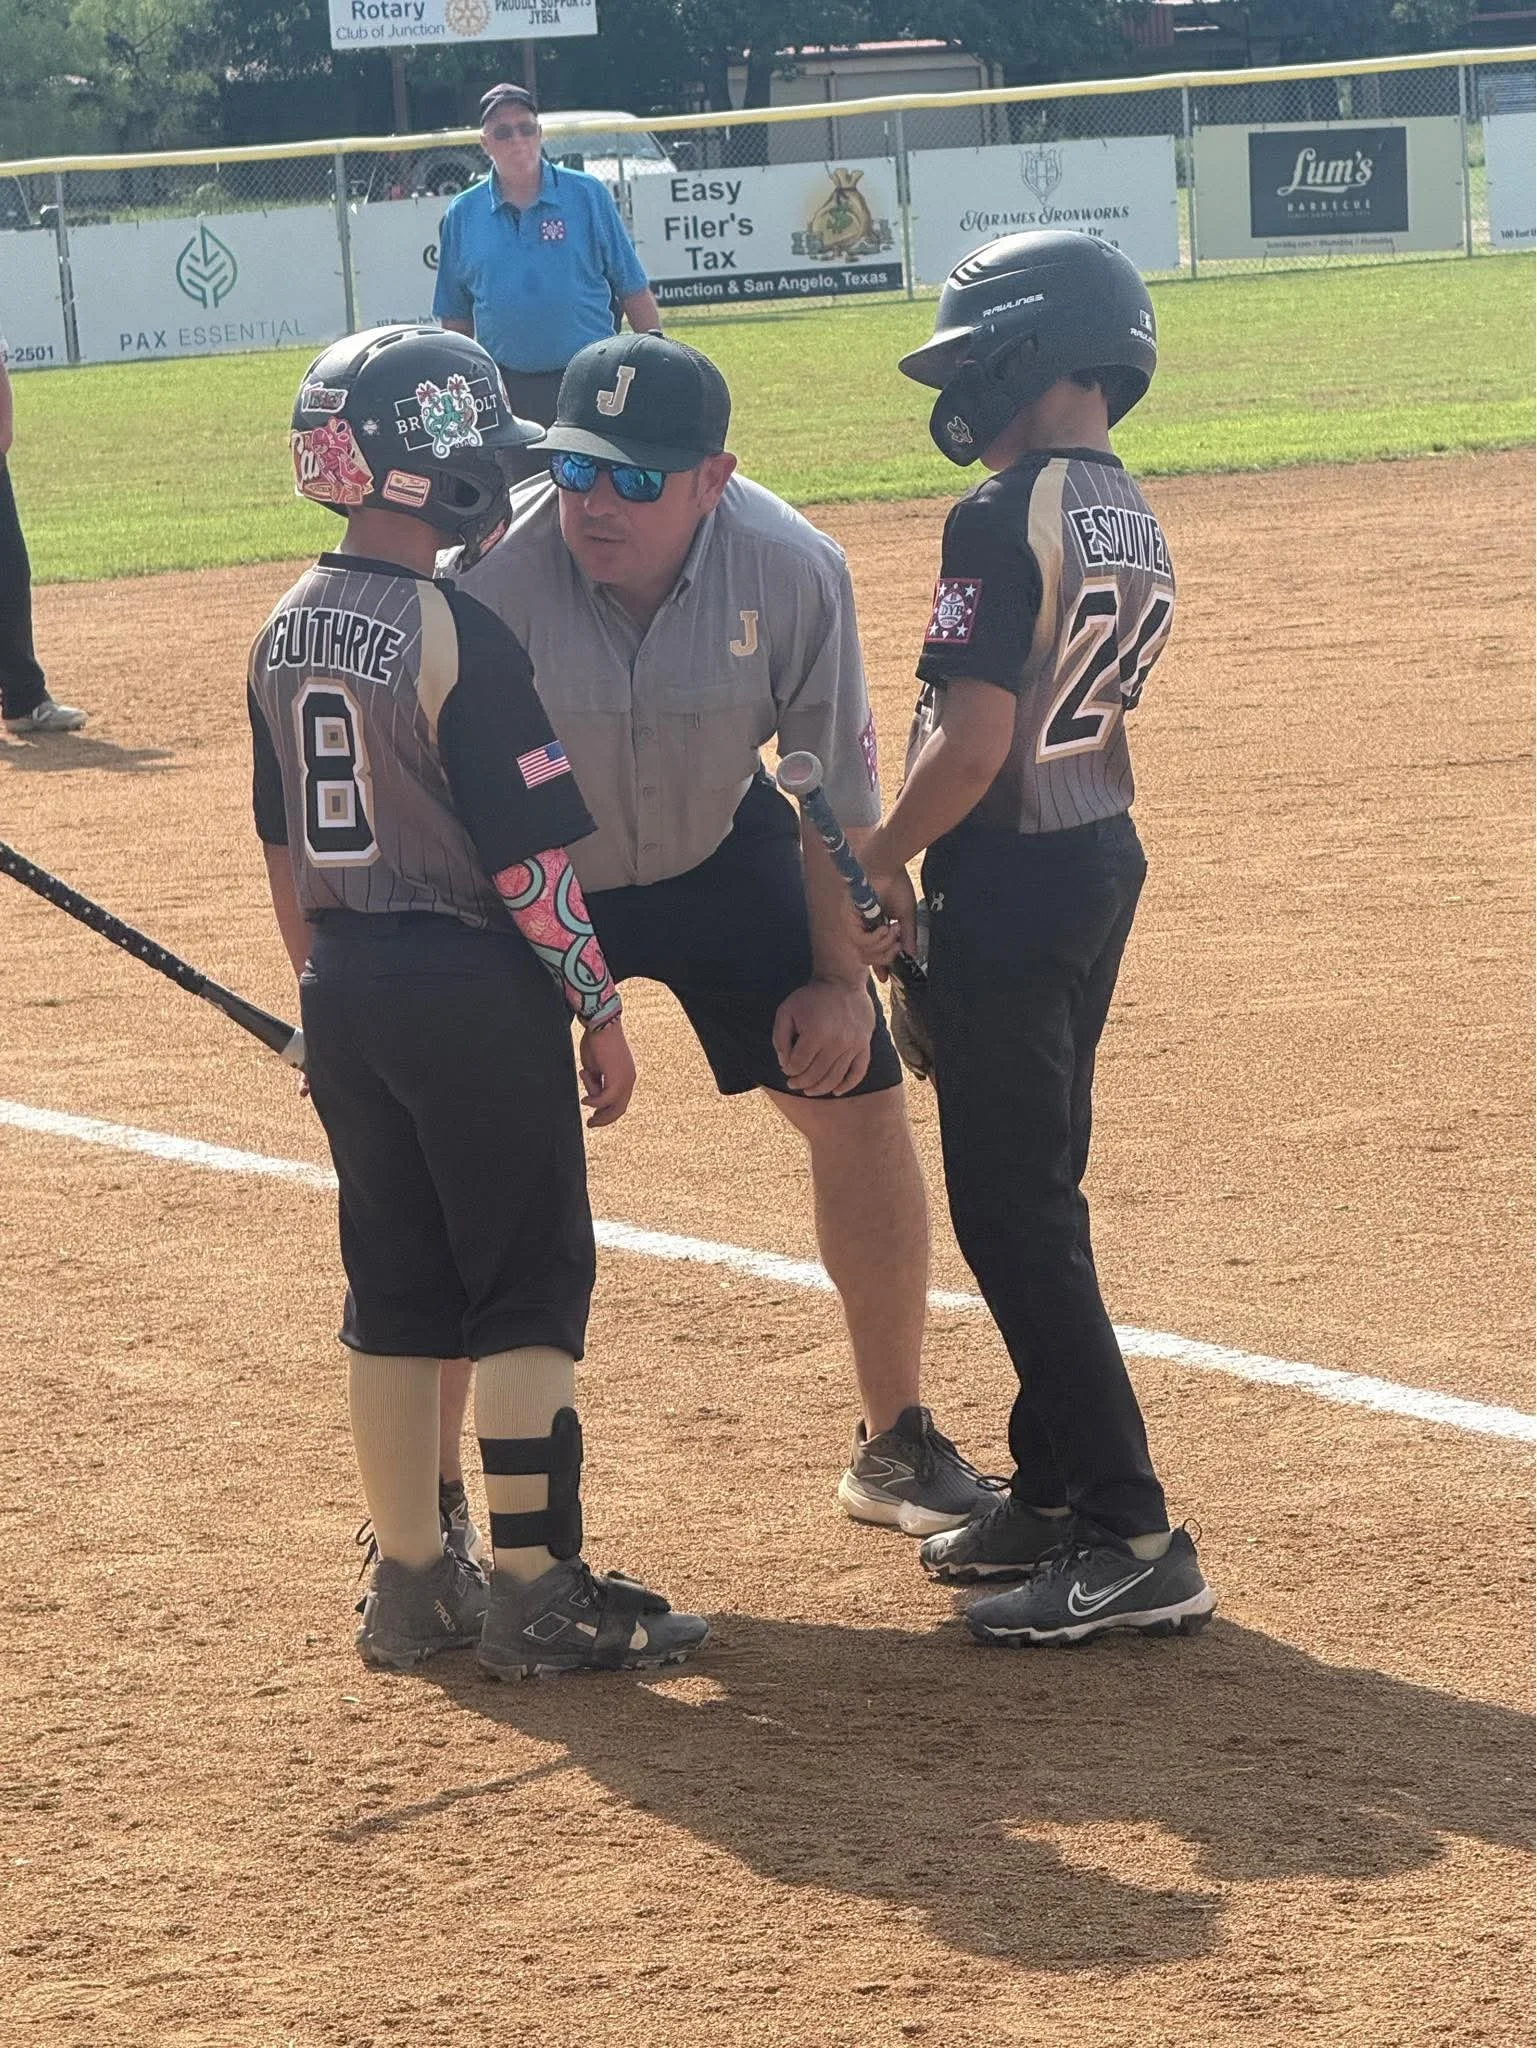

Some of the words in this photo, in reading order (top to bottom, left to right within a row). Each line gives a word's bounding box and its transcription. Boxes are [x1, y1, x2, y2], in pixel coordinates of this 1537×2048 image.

[351, 0, 425, 20] Rotary
[495, 0, 537, 11] PROUDLY
[528, 9, 561, 24] JYBSA
[336, 24, 368, 41] Club
[372, 23, 386, 38] of
[388, 21, 445, 38] Junction
[1277, 148, 1373, 196] Lum's
[671, 178, 743, 206] Easy
[664, 214, 755, 242] Filer's
[959, 210, 1036, 232] HARAMES
[1038, 204, 1129, 226] IRONWORKS
[685, 246, 738, 271] Tax
[655, 281, 725, 300] Junction
[728, 279, 740, 294] &
[743, 277, 774, 294] San
[777, 274, 838, 294] Angelo,
[842, 271, 888, 287] Texas
[982, 293, 1045, 318] RAWLINGS
[119, 330, 167, 351] PAX
[178, 318, 306, 346] ESSENTIAL
[1130, 327, 1156, 348] RAWLIN
[596, 365, 636, 417] J
[266, 606, 406, 685] GUTHRIE
[729, 610, 759, 658] J
[291, 676, 381, 868] 8
